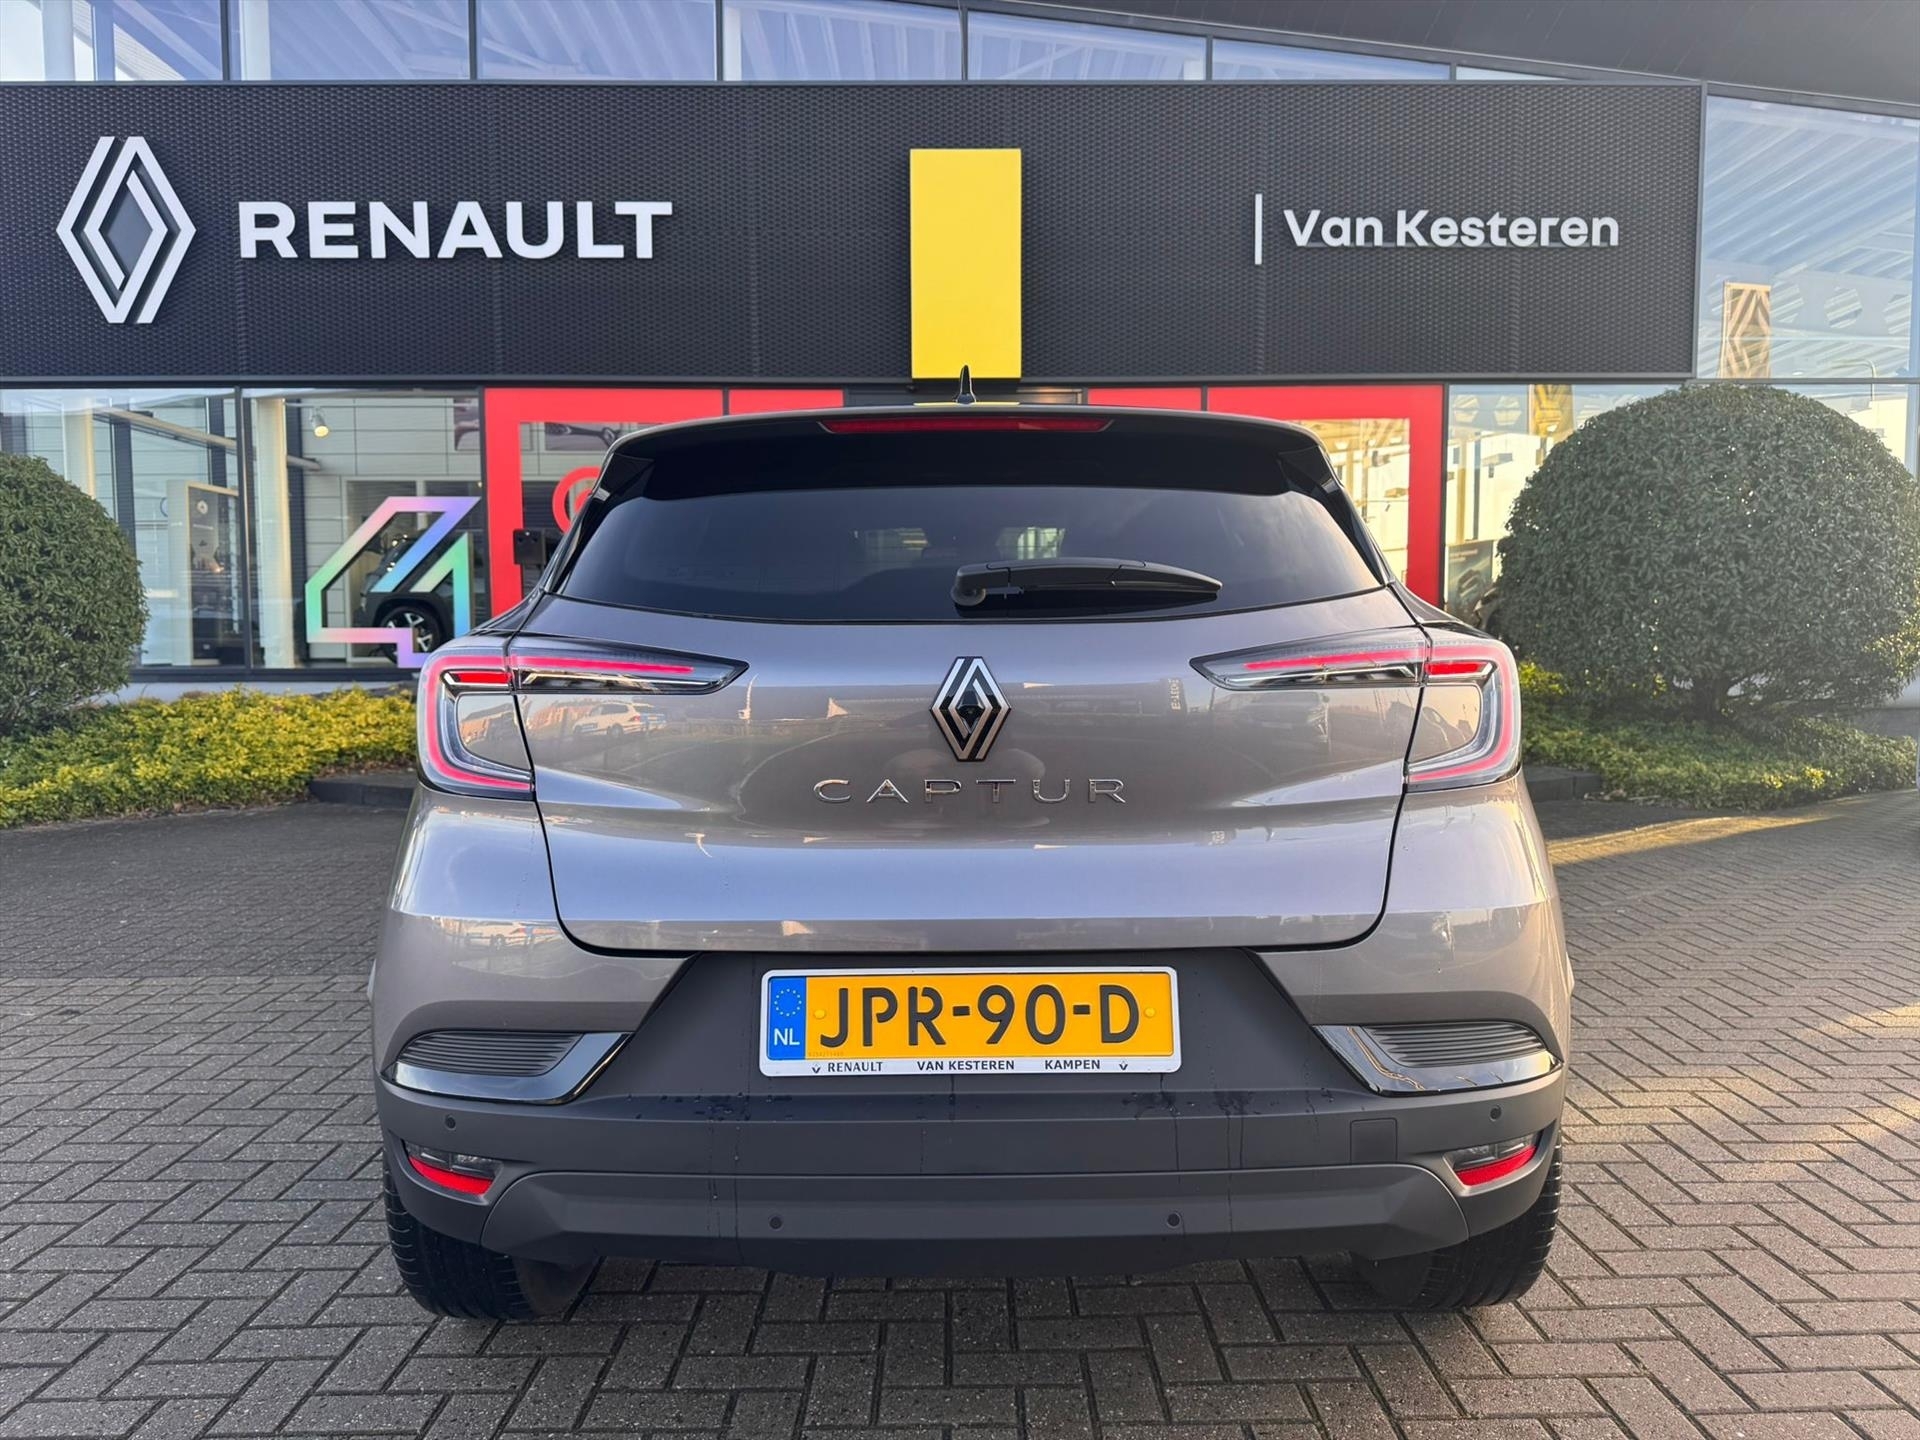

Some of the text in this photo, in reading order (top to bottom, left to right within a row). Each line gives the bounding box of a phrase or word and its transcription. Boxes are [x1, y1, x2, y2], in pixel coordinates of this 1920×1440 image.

[239, 200, 673, 260] RENAULT
[1283, 209, 1620, 248] Van Kesteren
[813, 778, 1127, 804] CAPTUR
[819, 984, 1140, 1048] JPR-90-D
[773, 1028, 801, 1047] NL
[827, 1059, 1101, 1073] RENAULT VAN KESTEREN KAMPEN
